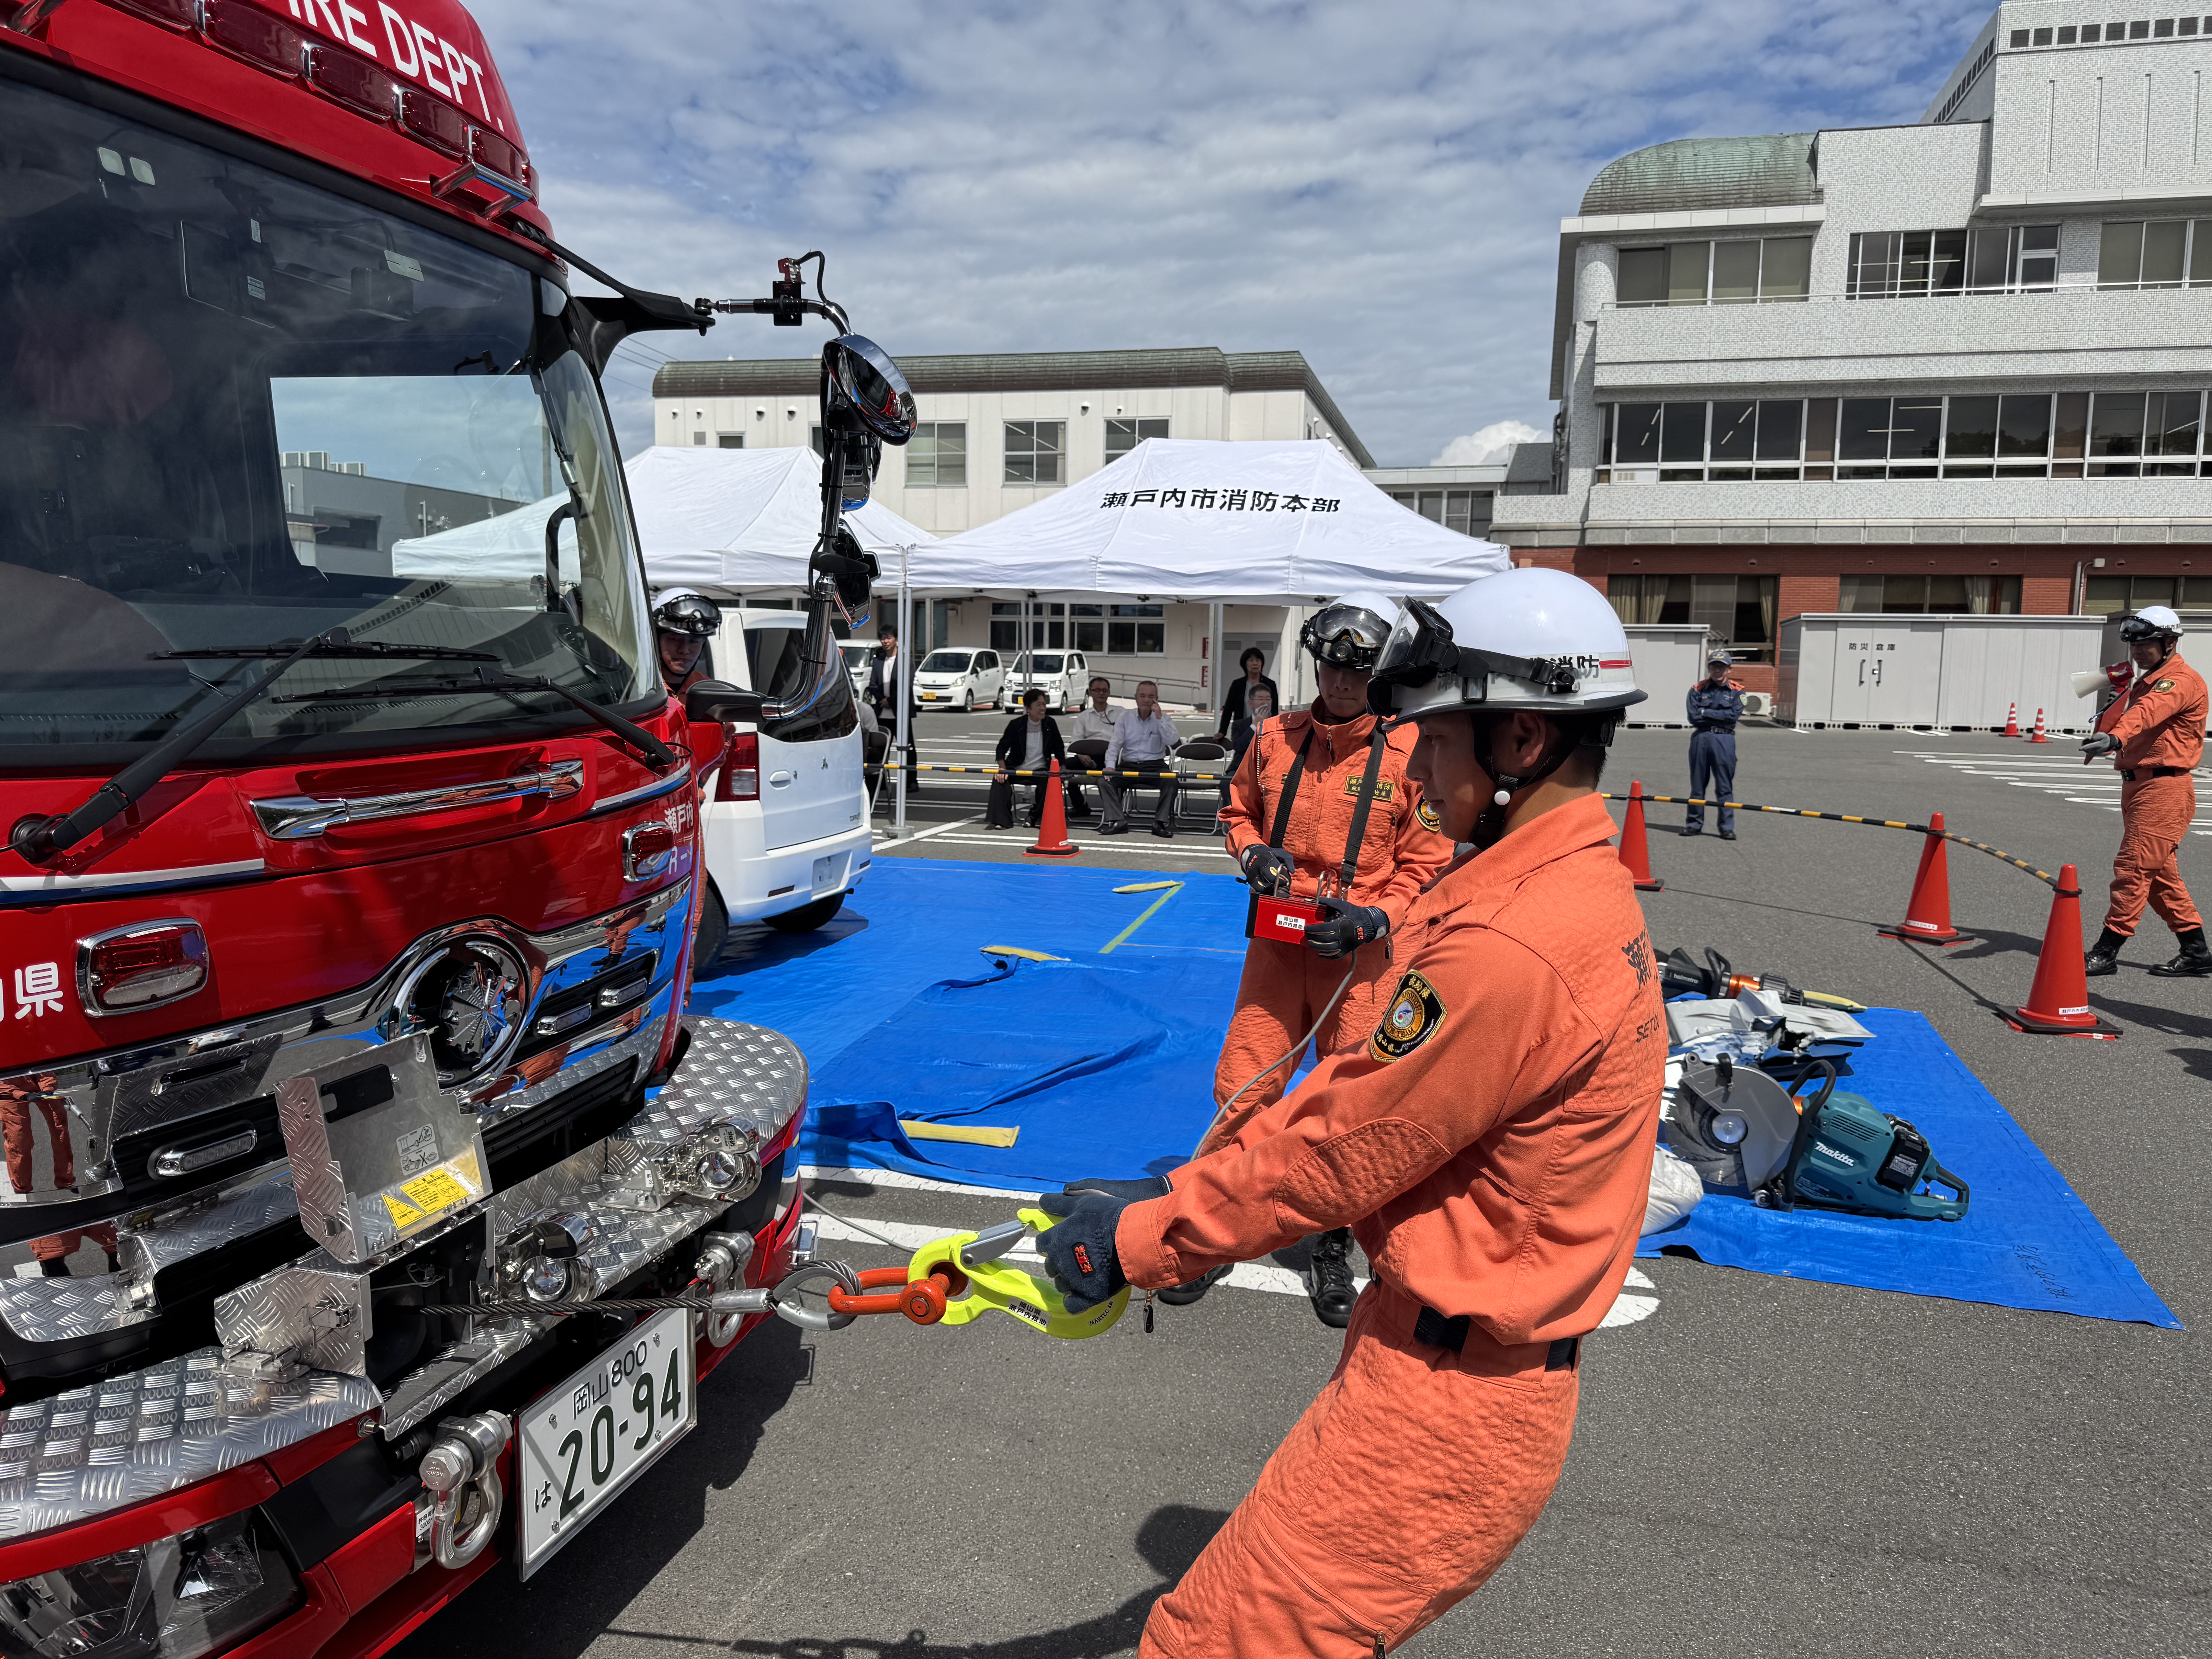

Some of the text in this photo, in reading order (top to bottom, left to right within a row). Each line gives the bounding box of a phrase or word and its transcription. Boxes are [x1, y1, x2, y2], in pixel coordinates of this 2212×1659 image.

[1100, 488, 1340, 513] 瀬戸内市消防本部
[1396, 1027, 1415, 1037] TEAM
[1008, 1303, 1046, 1326] 瀬戸内救助
[1019, 1301, 1041, 1316] 岡山県
[1090, 1309, 1109, 1326] MARTEC
[572, 1340, 647, 1420] 岡山 800
[558, 1346, 682, 1520] 20-94
[535, 1480, 551, 1513] は
